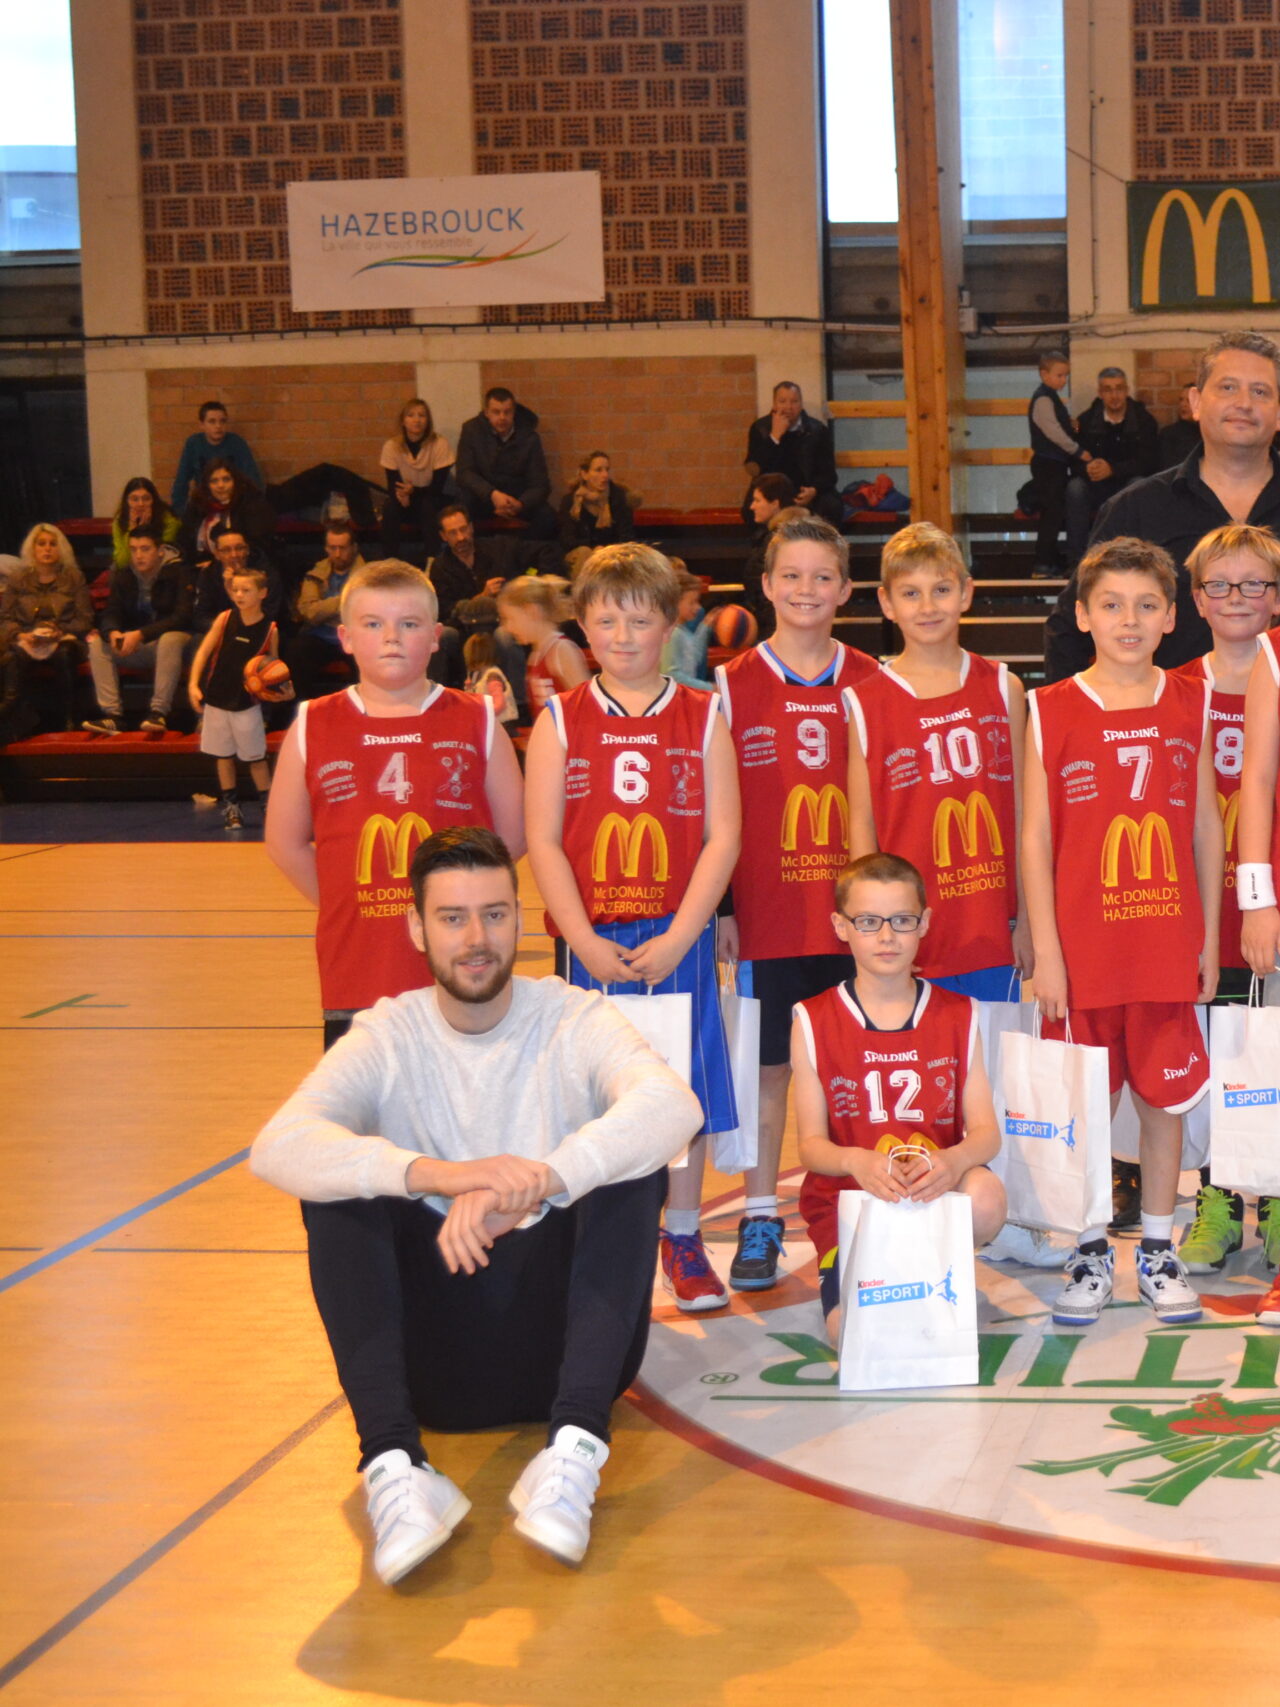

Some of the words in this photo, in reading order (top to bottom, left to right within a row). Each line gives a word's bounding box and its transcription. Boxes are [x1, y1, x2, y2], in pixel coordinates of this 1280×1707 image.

[320, 207, 525, 238] HAZEBROUCK
[785, 701, 838, 714] SPALDING
[919, 707, 972, 730] SPALDING
[363, 733, 423, 746] SPALDING
[601, 733, 659, 745] SPALDING
[1103, 726, 1160, 742] SPALDING
[797, 719, 830, 769] 9
[923, 726, 983, 785] 10
[1214, 727, 1244, 779] 8
[377, 752, 414, 804] 4
[613, 751, 650, 803] 6
[1117, 745, 1153, 801] 7
[781, 855, 799, 868] Mc
[782, 869, 840, 883] HAZEBROU
[937, 872, 955, 885] Mc
[358, 890, 374, 902] Mc
[609, 886, 665, 899] DONALD'S
[1102, 893, 1120, 906] Mc
[1123, 887, 1181, 904] DONALD'S
[593, 901, 663, 915] HAZEBROUCK
[1104, 903, 1182, 922] HAZEBROUCK
[864, 1050, 918, 1063] SPALDING
[864, 1069, 924, 1123] 12
[1236, 1091, 1273, 1105] SPORT
[1016, 1122, 1049, 1136] SPORT
[872, 1285, 920, 1302] SPORT
